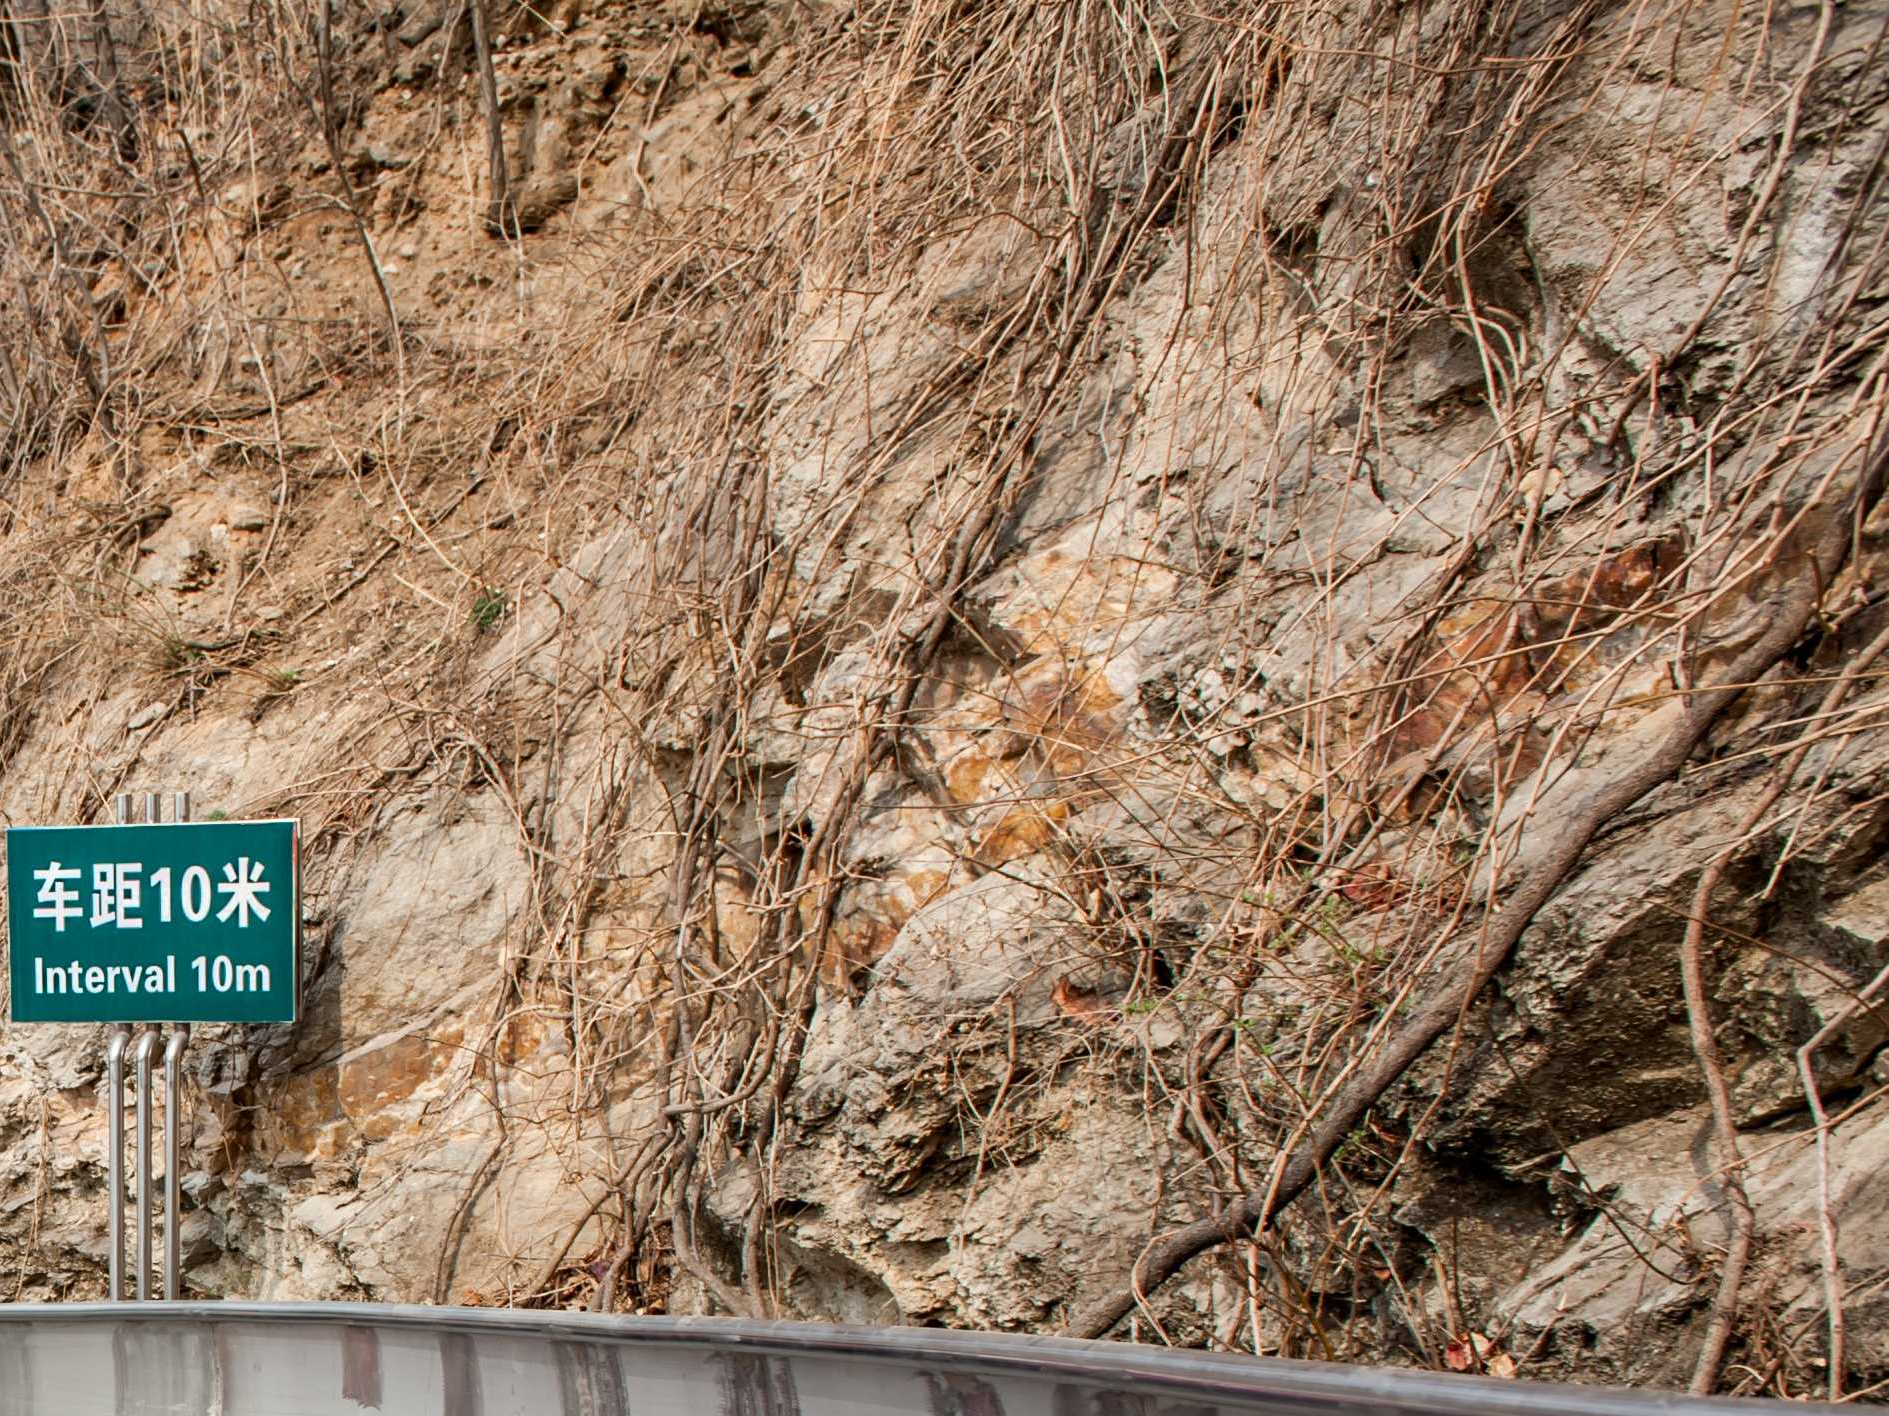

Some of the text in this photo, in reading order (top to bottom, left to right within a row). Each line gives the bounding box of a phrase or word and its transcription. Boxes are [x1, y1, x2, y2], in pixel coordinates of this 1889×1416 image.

[33, 856, 272, 932] 车距10米
[34, 955, 271, 994] Interval 10m
